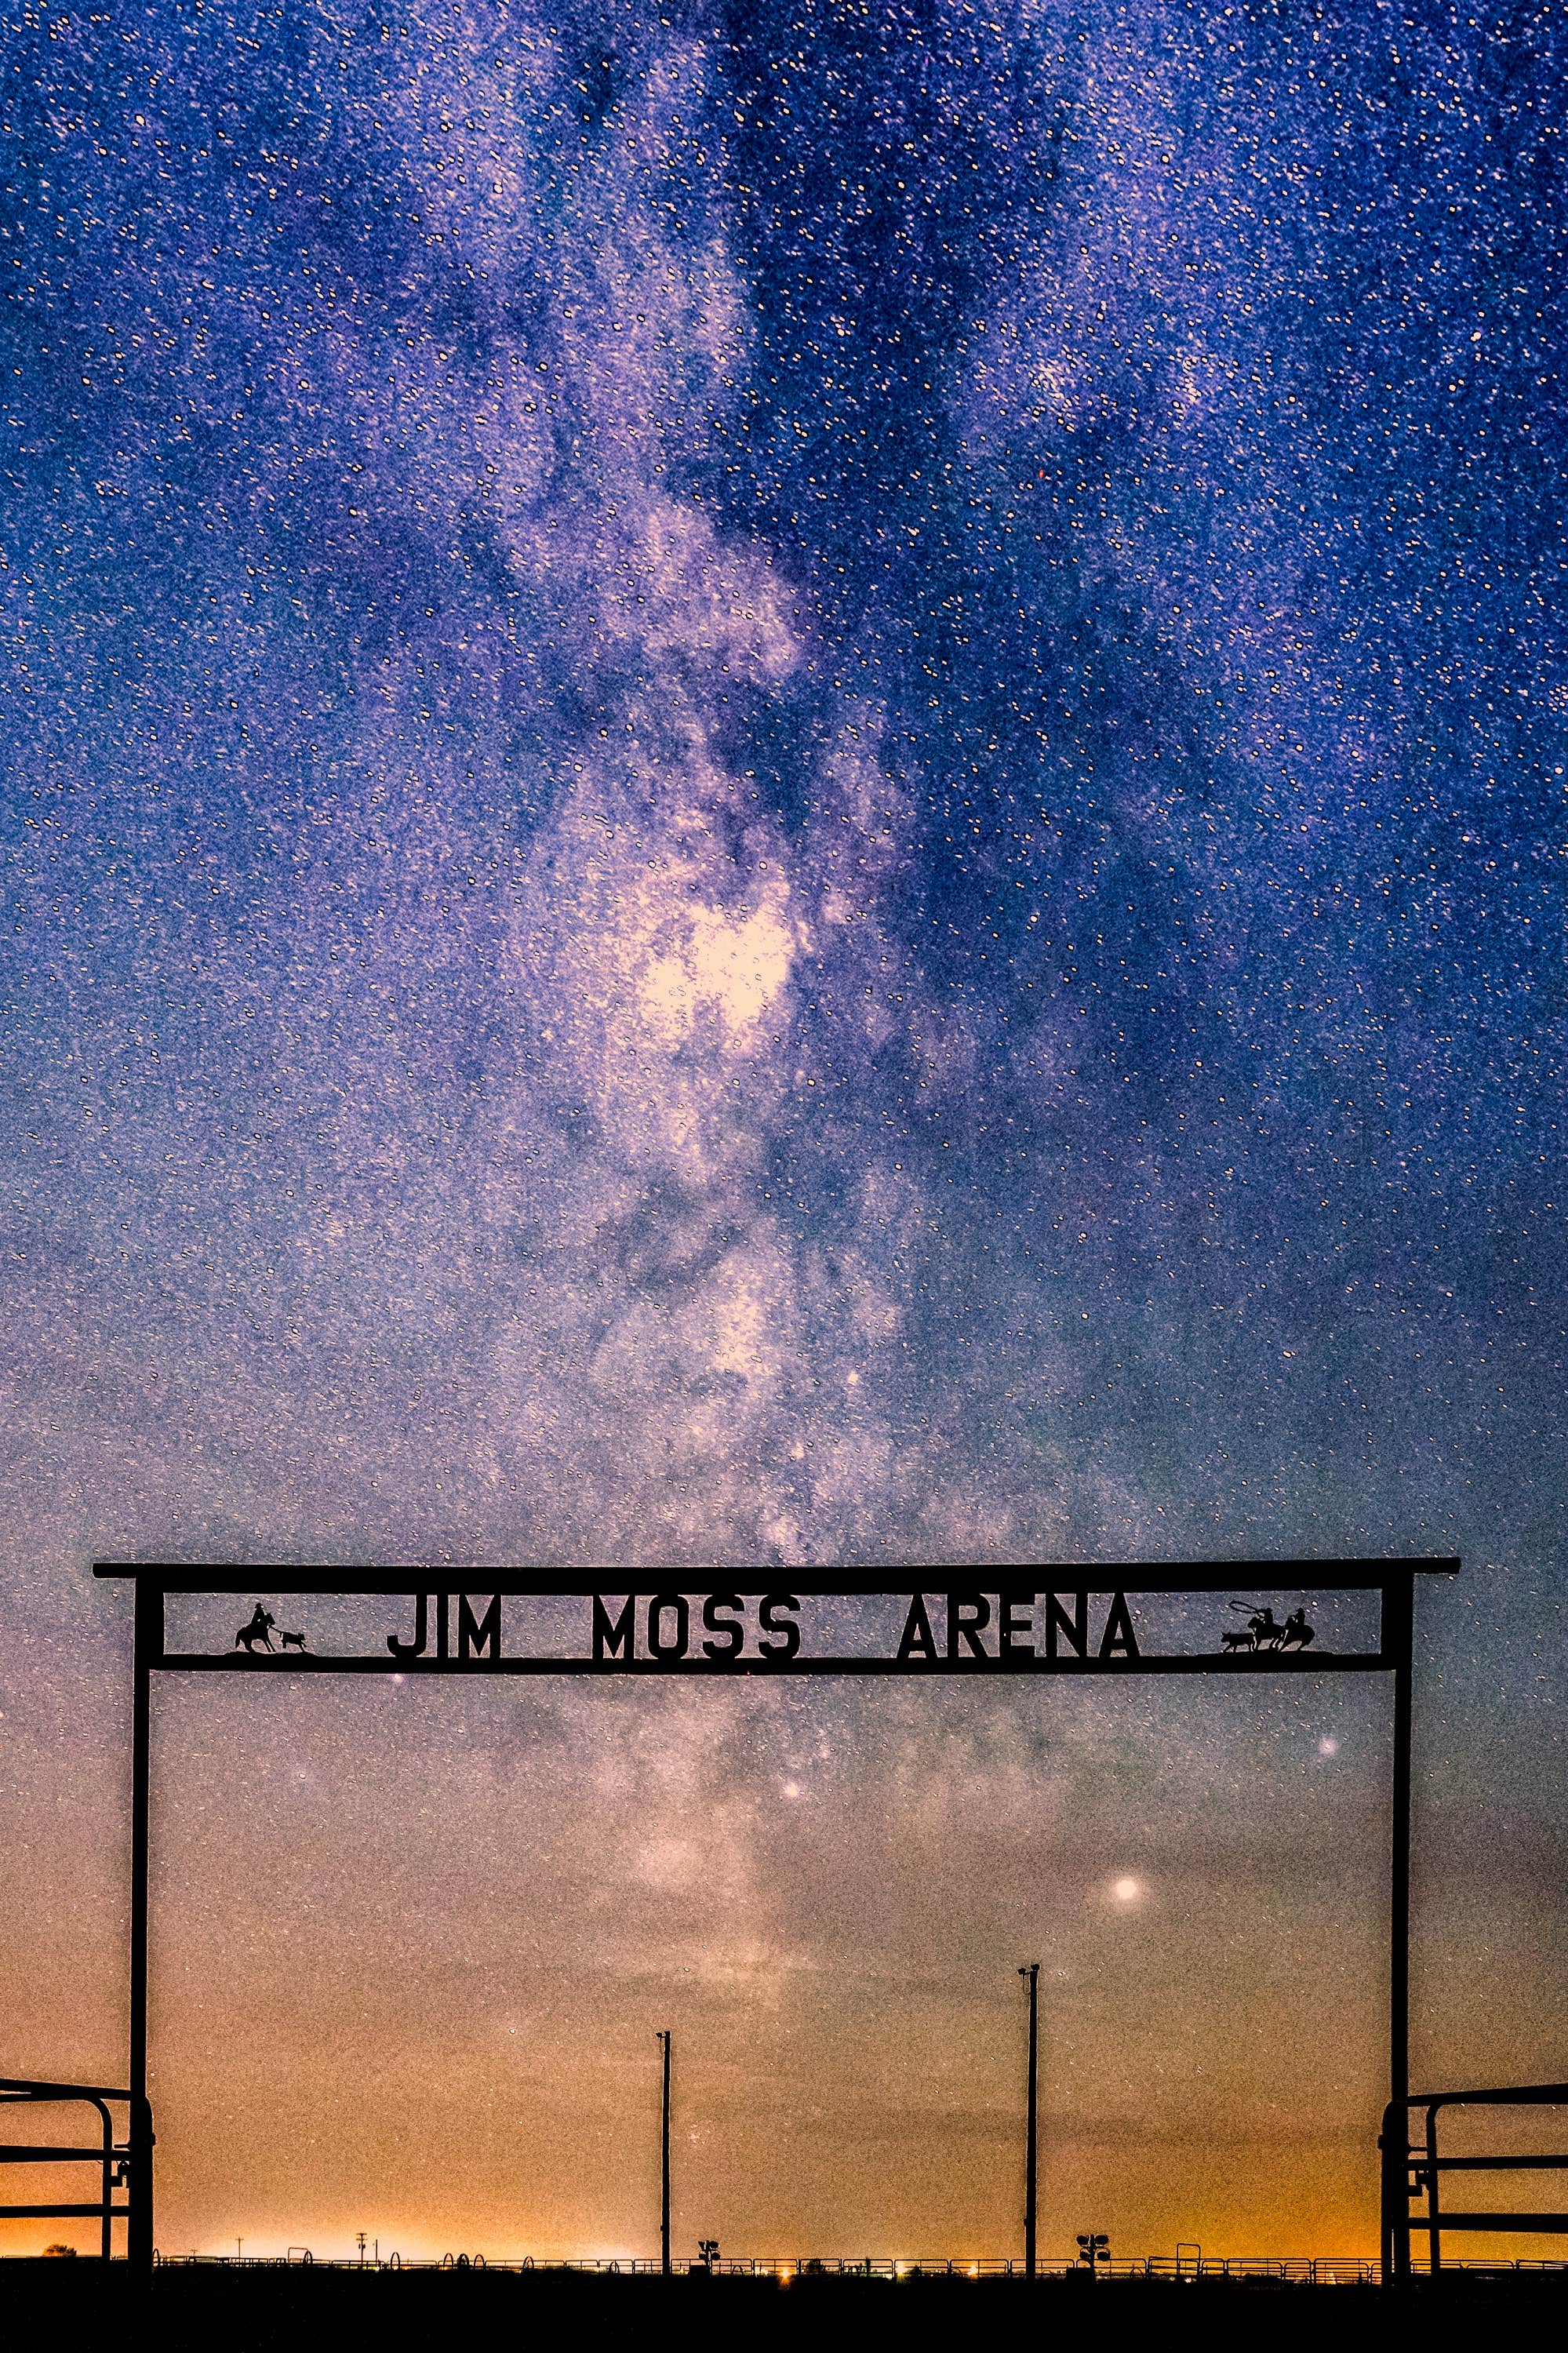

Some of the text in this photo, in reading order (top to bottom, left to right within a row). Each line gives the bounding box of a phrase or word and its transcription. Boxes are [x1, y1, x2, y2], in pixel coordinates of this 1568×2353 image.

[386, 1593, 1141, 1659] JIM MOSS ARENA
